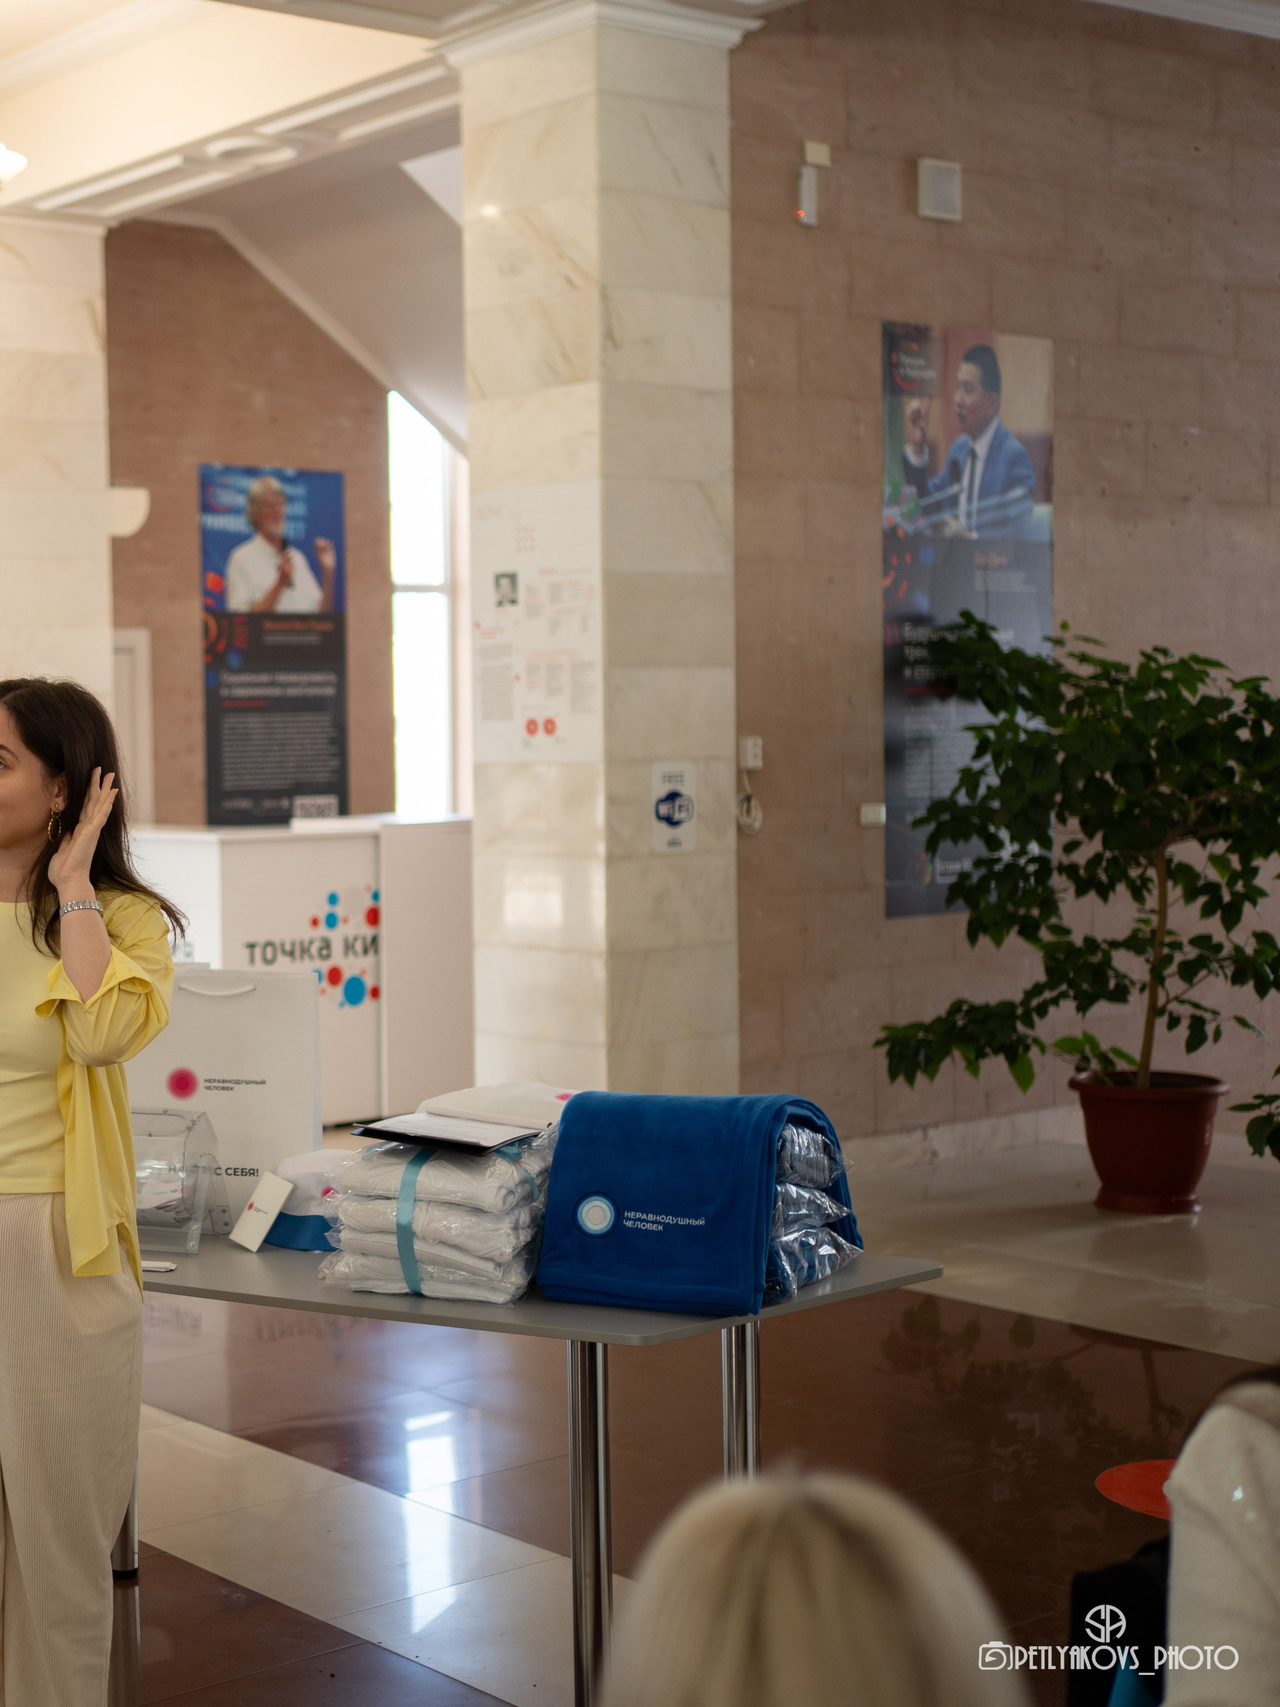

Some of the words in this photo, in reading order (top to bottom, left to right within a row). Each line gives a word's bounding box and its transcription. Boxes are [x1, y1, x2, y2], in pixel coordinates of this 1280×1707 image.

[245, 937, 332, 966] точка
[203, 1077, 266, 1086] НЕРАВНОДУШНЫЙ
[225, 1167, 259, 1177] СЕБЯ!
[624, 1210, 706, 1226] НЕРАВНОДУШНЫЙ
[623, 1219, 664, 1232] ЧЕЛОВЕК
